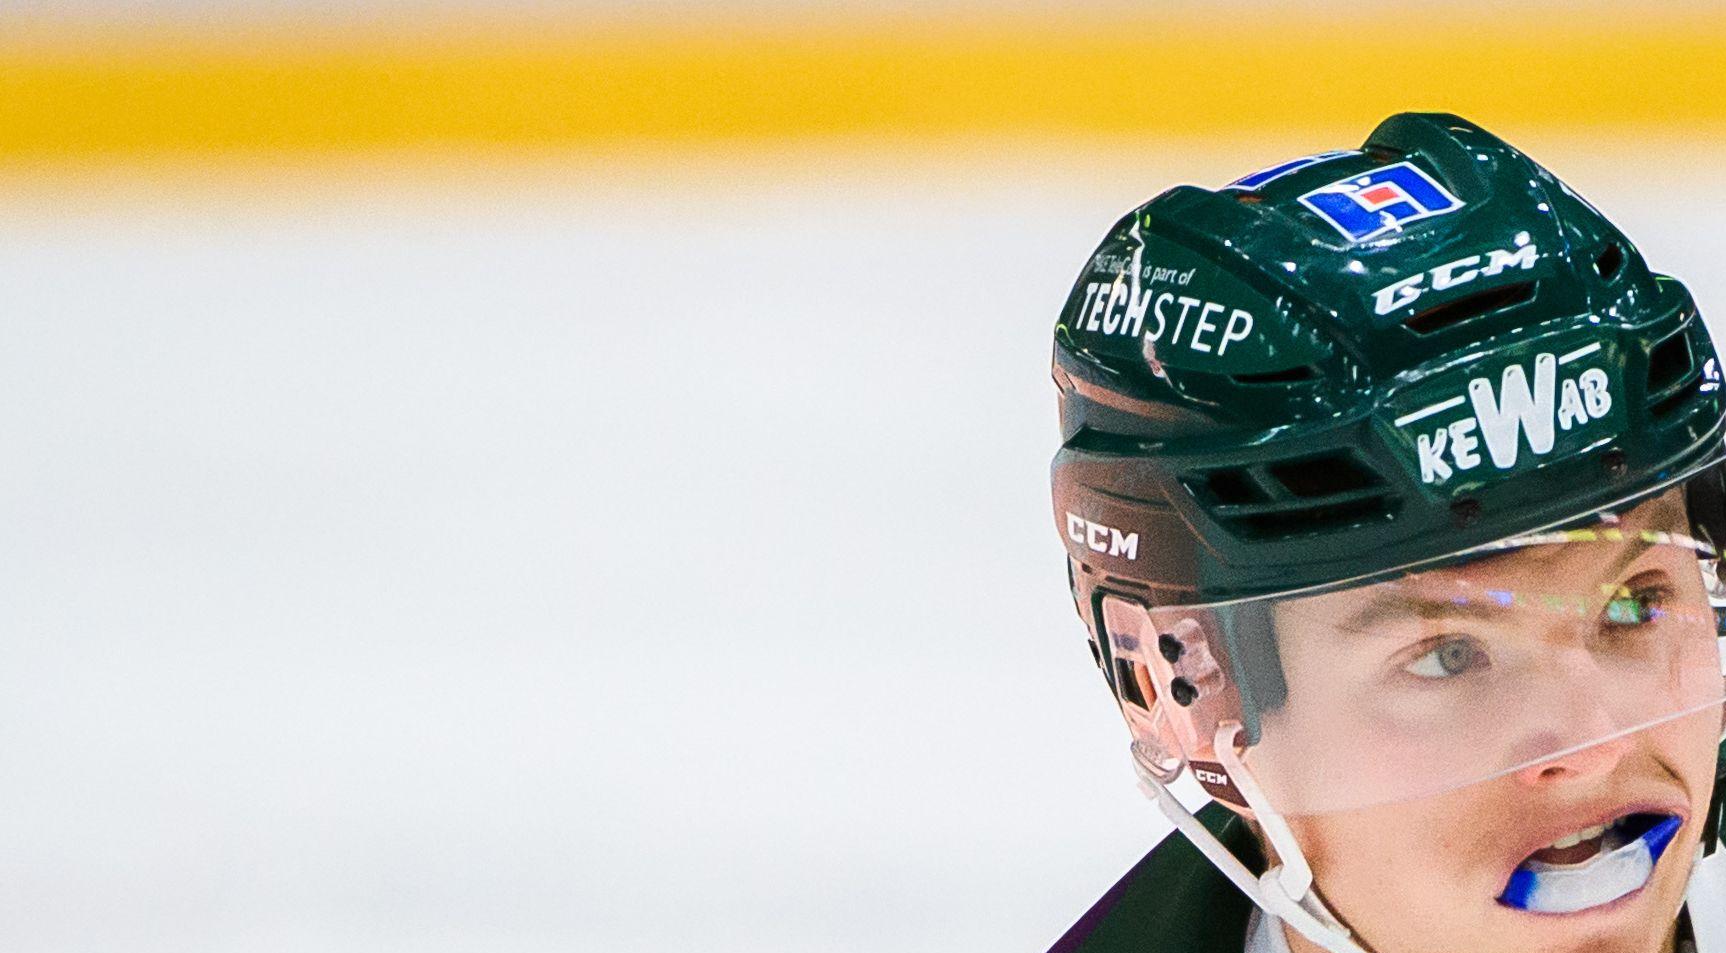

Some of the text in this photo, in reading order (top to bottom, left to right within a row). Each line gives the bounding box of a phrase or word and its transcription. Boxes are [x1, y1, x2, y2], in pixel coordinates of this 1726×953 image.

[1149, 266, 1178, 286] part
[1177, 268, 1197, 286] of
[1076, 282, 1253, 356] TECHSTEP
[1066, 511, 1140, 560] CCM
[1195, 768, 1228, 786] CCM
